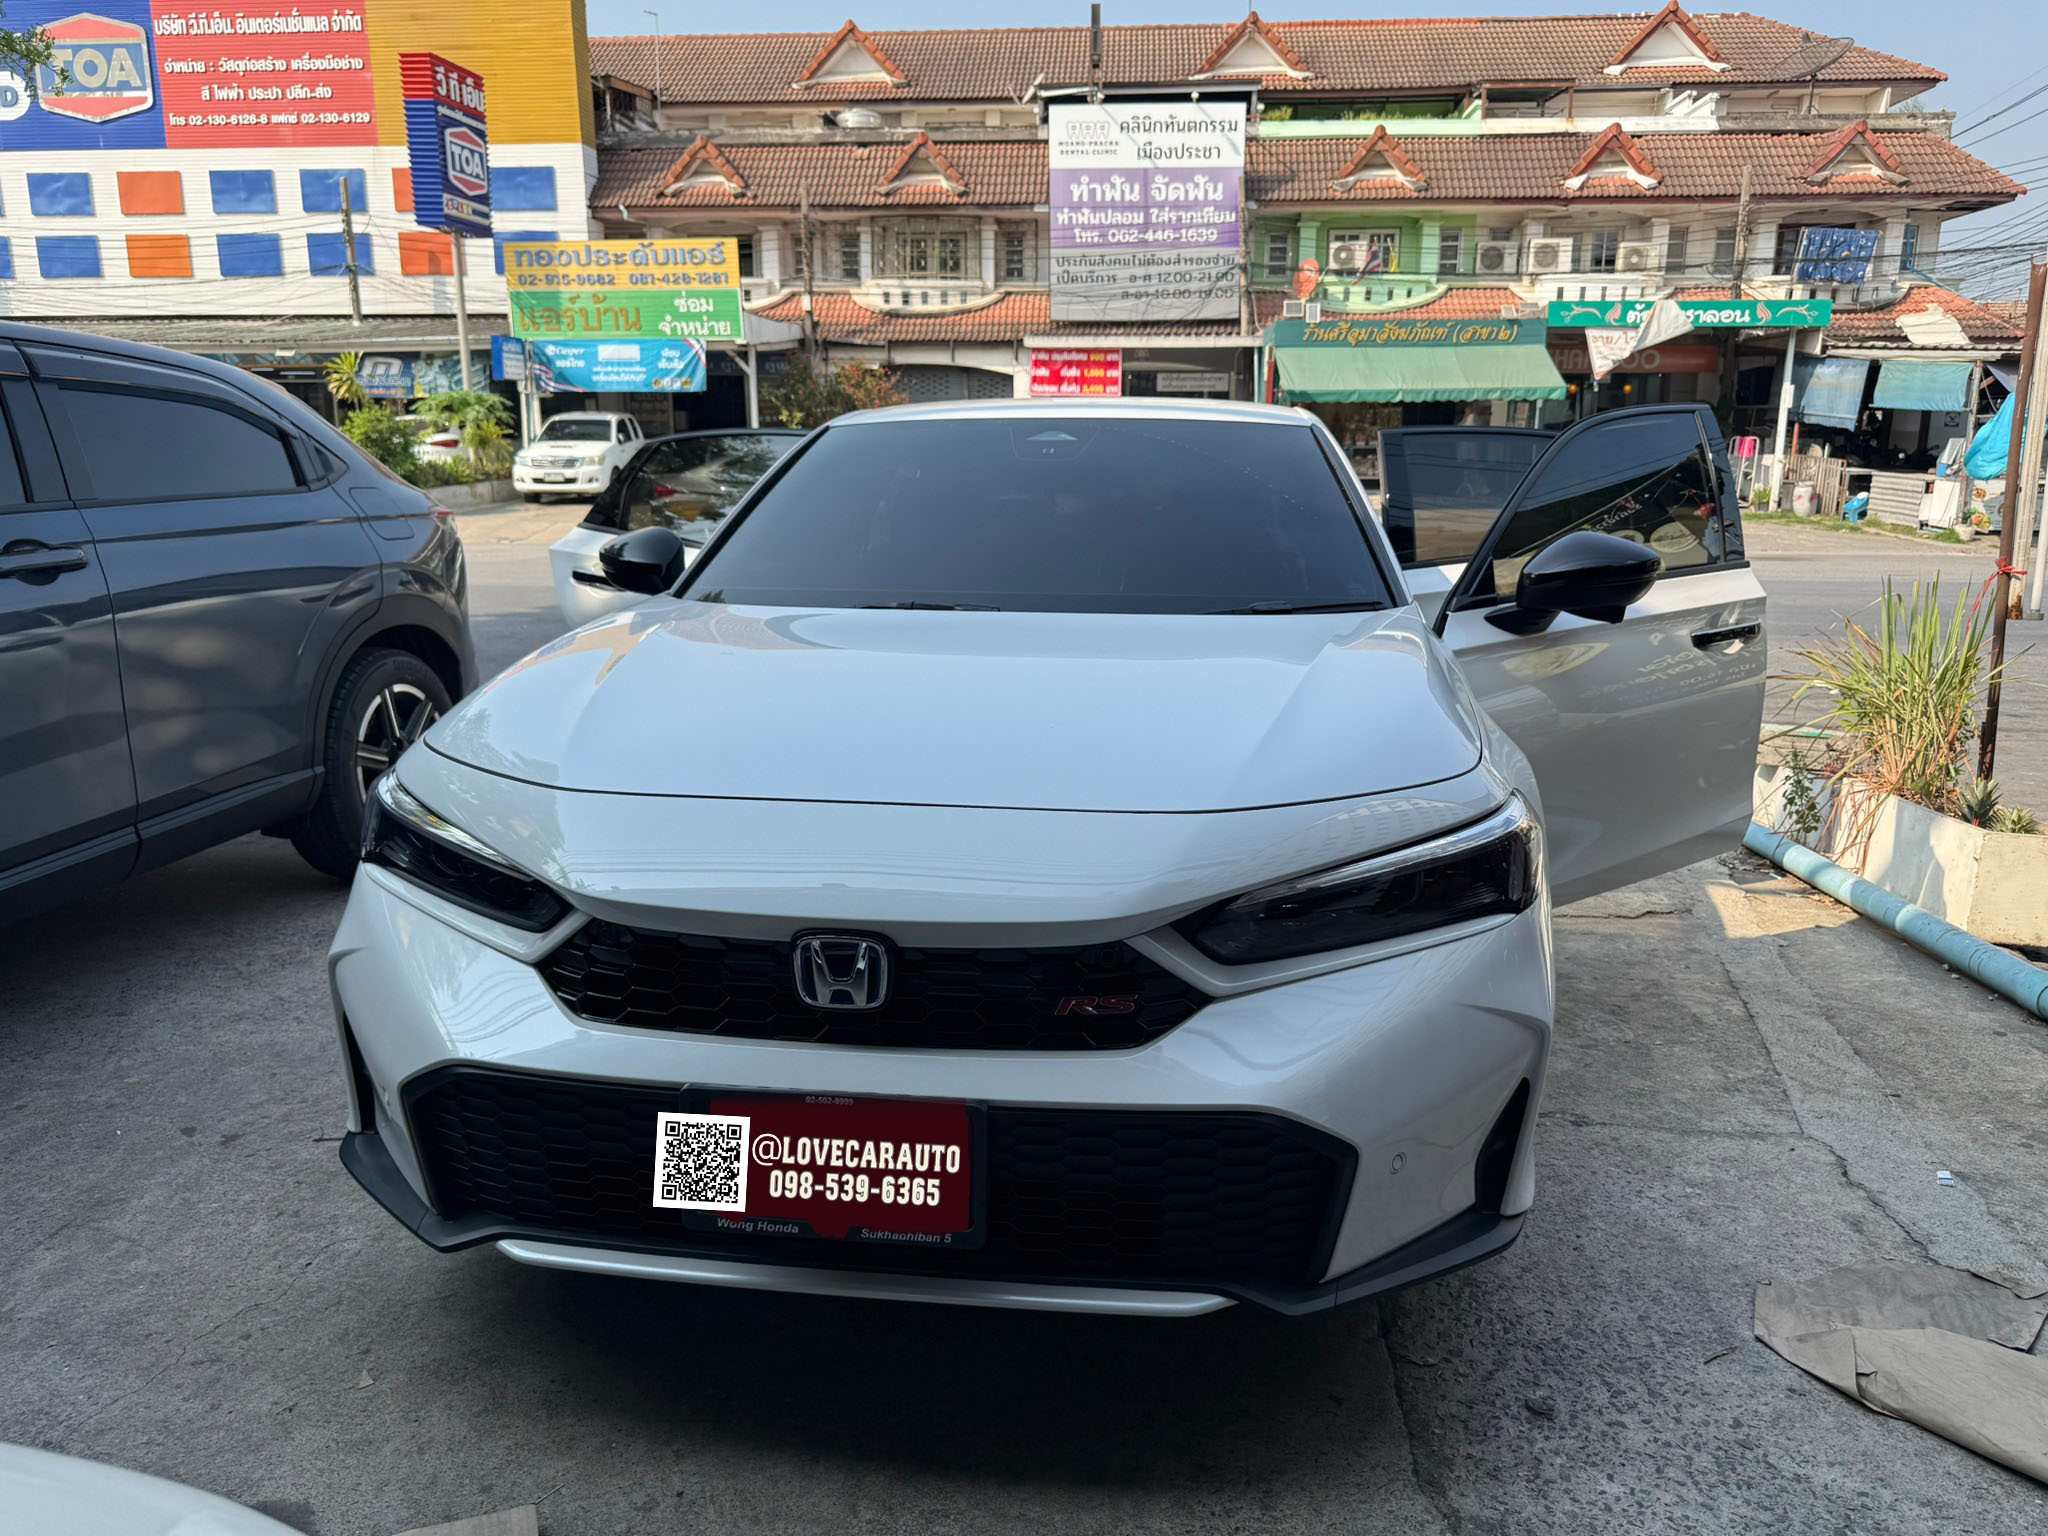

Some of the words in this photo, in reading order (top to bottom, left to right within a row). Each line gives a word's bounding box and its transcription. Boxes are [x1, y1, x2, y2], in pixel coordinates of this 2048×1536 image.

[154, 13, 186, 35] บริษัท
[235, 8, 329, 35] อินเตอร์เนชั่นแนล
[332, 9, 362, 33] จำกัด
[51, 47, 142, 88] TOA
[164, 57, 205, 74] จำหน่าย
[218, 55, 287, 76] วัสดุก่อสร้าง
[291, 52, 363, 72] เครื่องมือช่าง
[201, 85, 211, 101] สี
[212, 83, 244, 101] ไฟฟ้า
[248, 86, 282, 100] ประปา
[286, 83, 332, 99] ปลีก-ส่ง
[189, 113, 268, 126] 02-130-6126-8
[301, 112, 371, 125] 02-130-6129
[1120, 115, 1238, 134] คลินิกทันตกรรม
[450, 144, 484, 179] TOA
[1137, 142, 1221, 160] เมืองประชา
[1070, 174, 1140, 202] ทำฟัน
[1151, 173, 1224, 202] จัดฟัน
[1056, 207, 1144, 225] ทำฟันปลอม
[1149, 205, 1236, 224] ใส่รากเทียม
[1074, 228, 1103, 243] โทร.
[1108, 228, 1218, 243] 062-446-1639
[514, 241, 726, 268] ทองประดับแอร์
[674, 290, 714, 313] ซ่อม
[519, 293, 642, 332] แอร์บ้าน
[658, 315, 731, 336] จำหน่าย
[1055, 995, 1138, 1016] RS
[717, 1217, 754, 1232] Wong
[757, 1220, 800, 1234] Honda
[944, 1233, 952, 1244] 5
